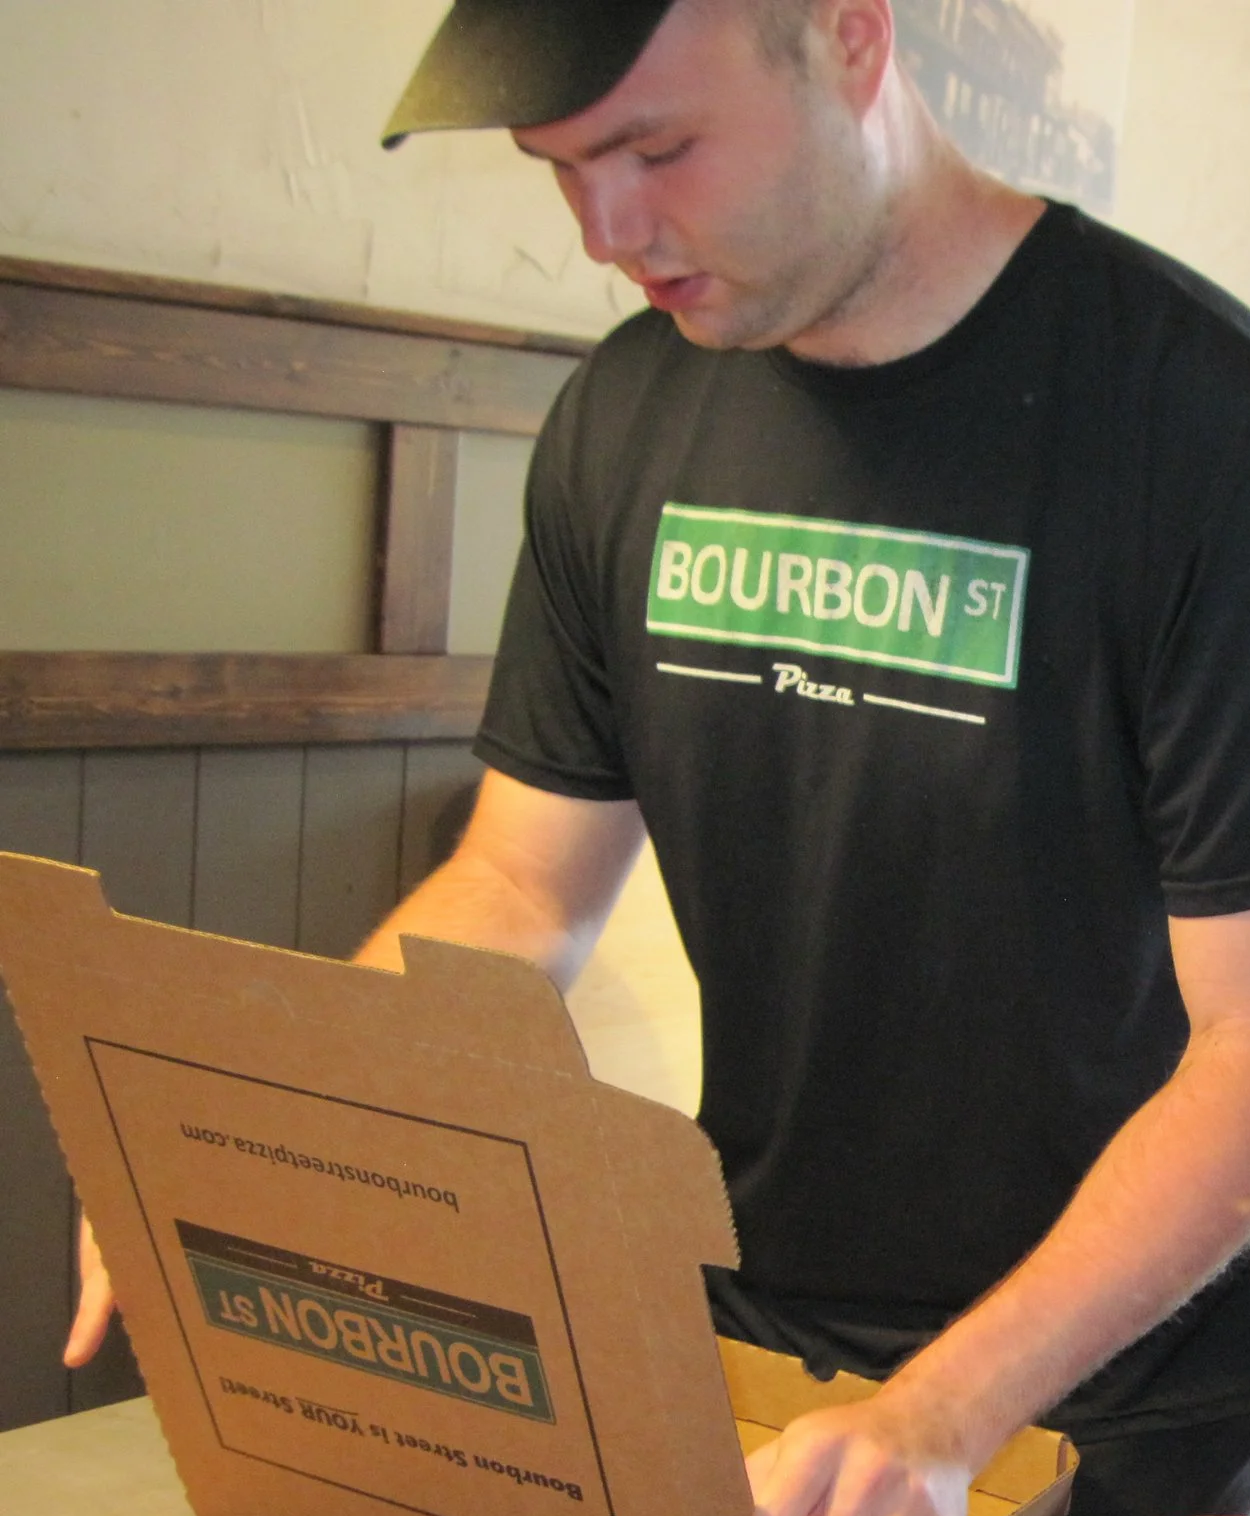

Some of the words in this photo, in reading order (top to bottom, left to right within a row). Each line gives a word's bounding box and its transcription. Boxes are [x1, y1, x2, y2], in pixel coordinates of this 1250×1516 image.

[656, 540, 951, 638] BOURBON
[963, 578, 1007, 620] ST
[772, 662, 855, 706] Pizza
[179, 1122, 460, 1213] bourbonstreetpizza.com
[309, 1258, 389, 1302] Pizza
[219, 1290, 258, 1328] ST
[258, 1286, 535, 1407] BOURBON
[218, 1376, 294, 1414] Street!
[302, 1404, 364, 1436] YOUR
[370, 1422, 390, 1444] is
[394, 1430, 468, 1468] Street
[473, 1454, 584, 1502] Bourbon
